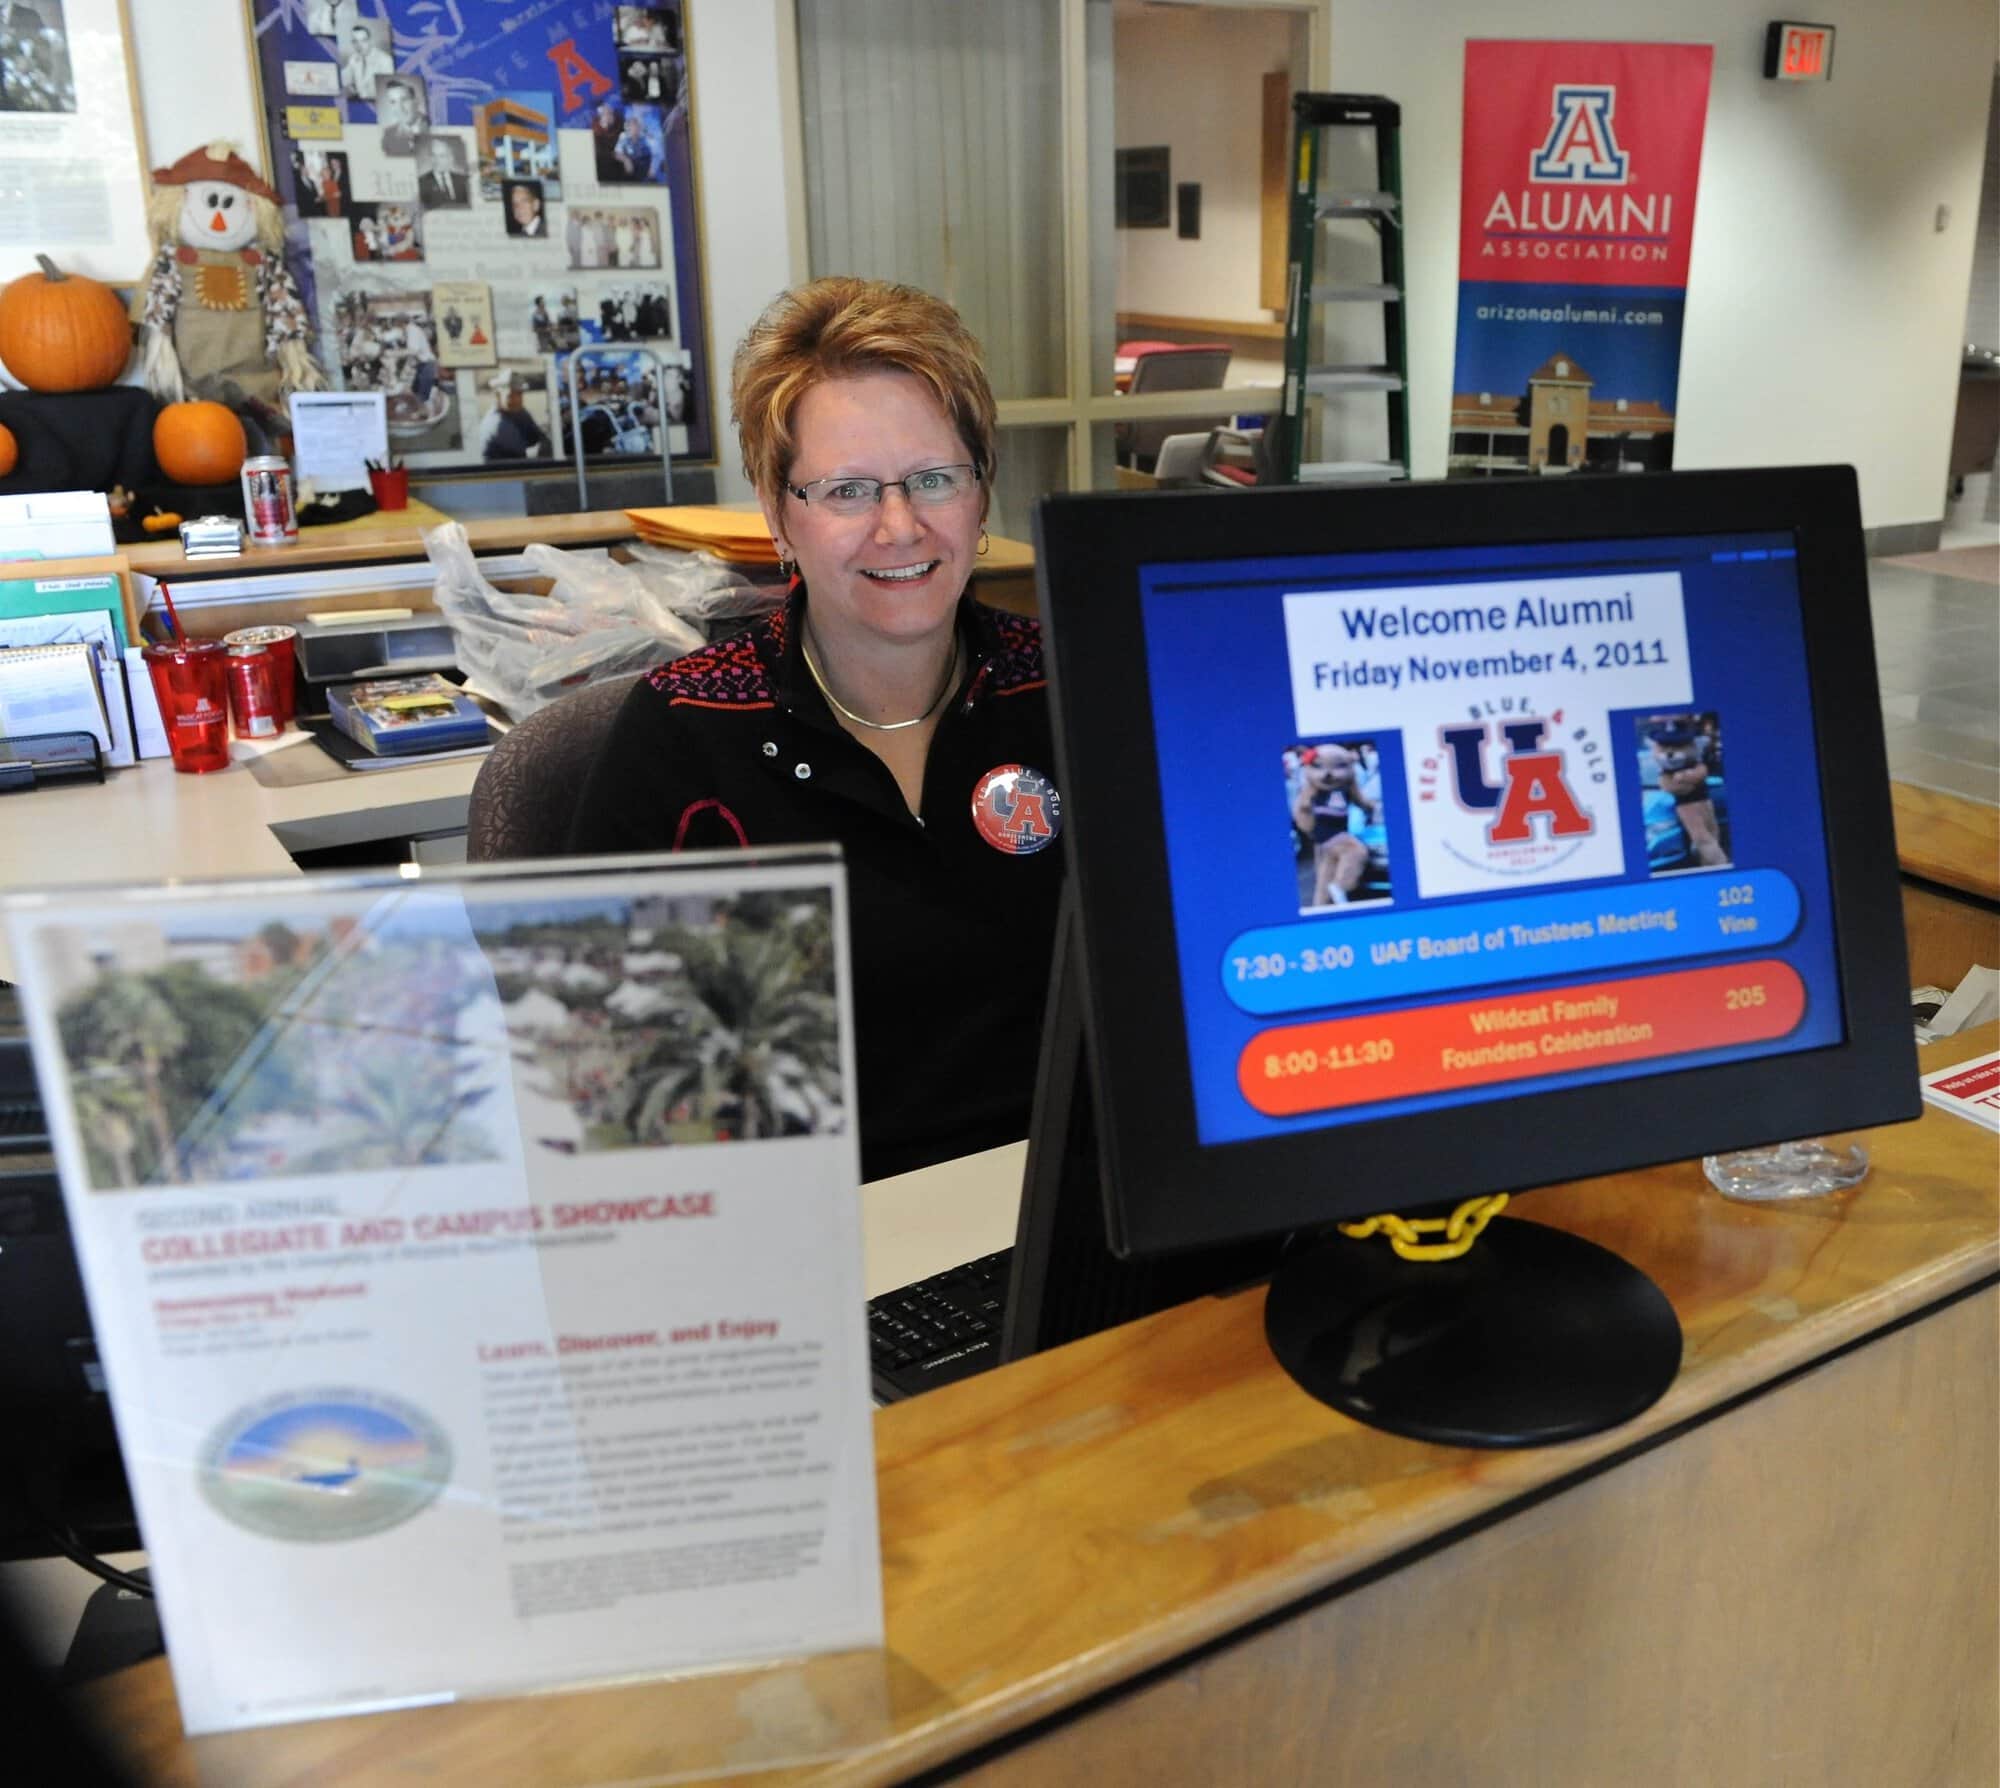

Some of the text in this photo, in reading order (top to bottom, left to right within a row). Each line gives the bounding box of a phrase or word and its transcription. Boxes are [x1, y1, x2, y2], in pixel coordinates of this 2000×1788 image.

[1784, 30, 1824, 74] EXIT
[547, 38, 613, 113] A
[1529, 83, 1630, 185] A
[1483, 189, 1672, 234] ALUMNI
[1482, 241, 1668, 262] ASSOCIATION
[1476, 303, 1664, 325] arizonaalumni.com
[1342, 592, 1634, 639] Welcome Alumni
[1313, 639, 1669, 690] Friday November 4, 2011
[1718, 885, 1754, 907] 102
[1232, 953, 1286, 981] 7:30
[1301, 945, 1354, 973] 3:00
[1370, 939, 1413, 966] UAF
[1417, 931, 1479, 960] Board
[1484, 927, 1505, 949] of
[1509, 919, 1594, 947] Trustees
[1597, 909, 1677, 934] Meeting
[1719, 915, 1758, 935] Vine
[1470, 995, 1619, 1034] Wildcat Family
[1725, 985, 1767, 1011] 205
[1264, 1050, 1317, 1079] 8:00
[1441, 1022, 1653, 1071] Founders Celebration
[140, 1190, 716, 1265] COLLEGIATE AND CAMPUS SHOWCASE
[478, 1317, 780, 1363] Learn, Discover, and Enjoy
